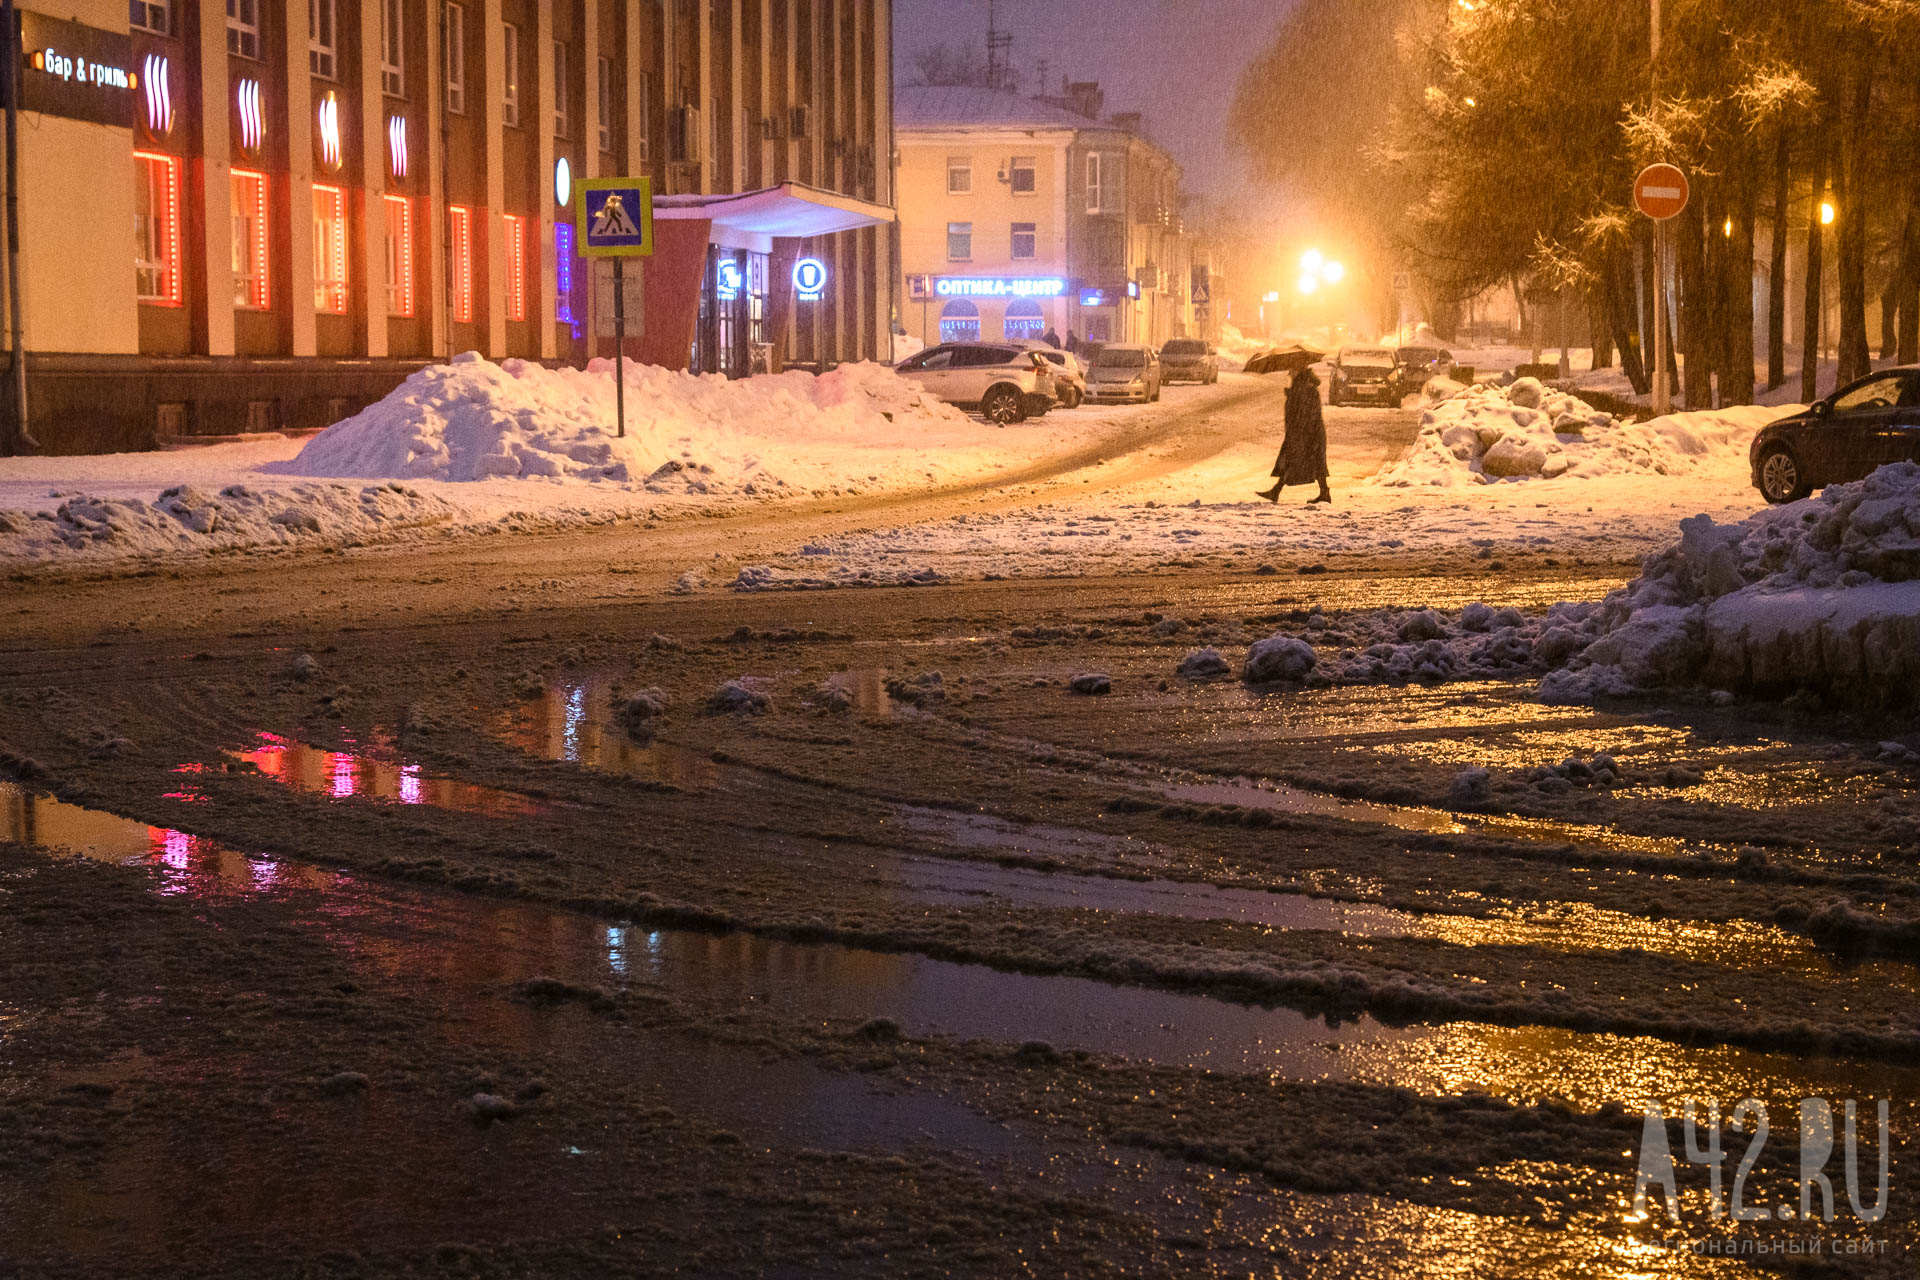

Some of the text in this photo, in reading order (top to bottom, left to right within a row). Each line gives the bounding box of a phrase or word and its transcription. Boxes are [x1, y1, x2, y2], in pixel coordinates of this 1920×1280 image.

[45, 48, 128, 88] бар & гриль
[937, 279, 1063, 297] ОПТИКА-ЦЕНТР
